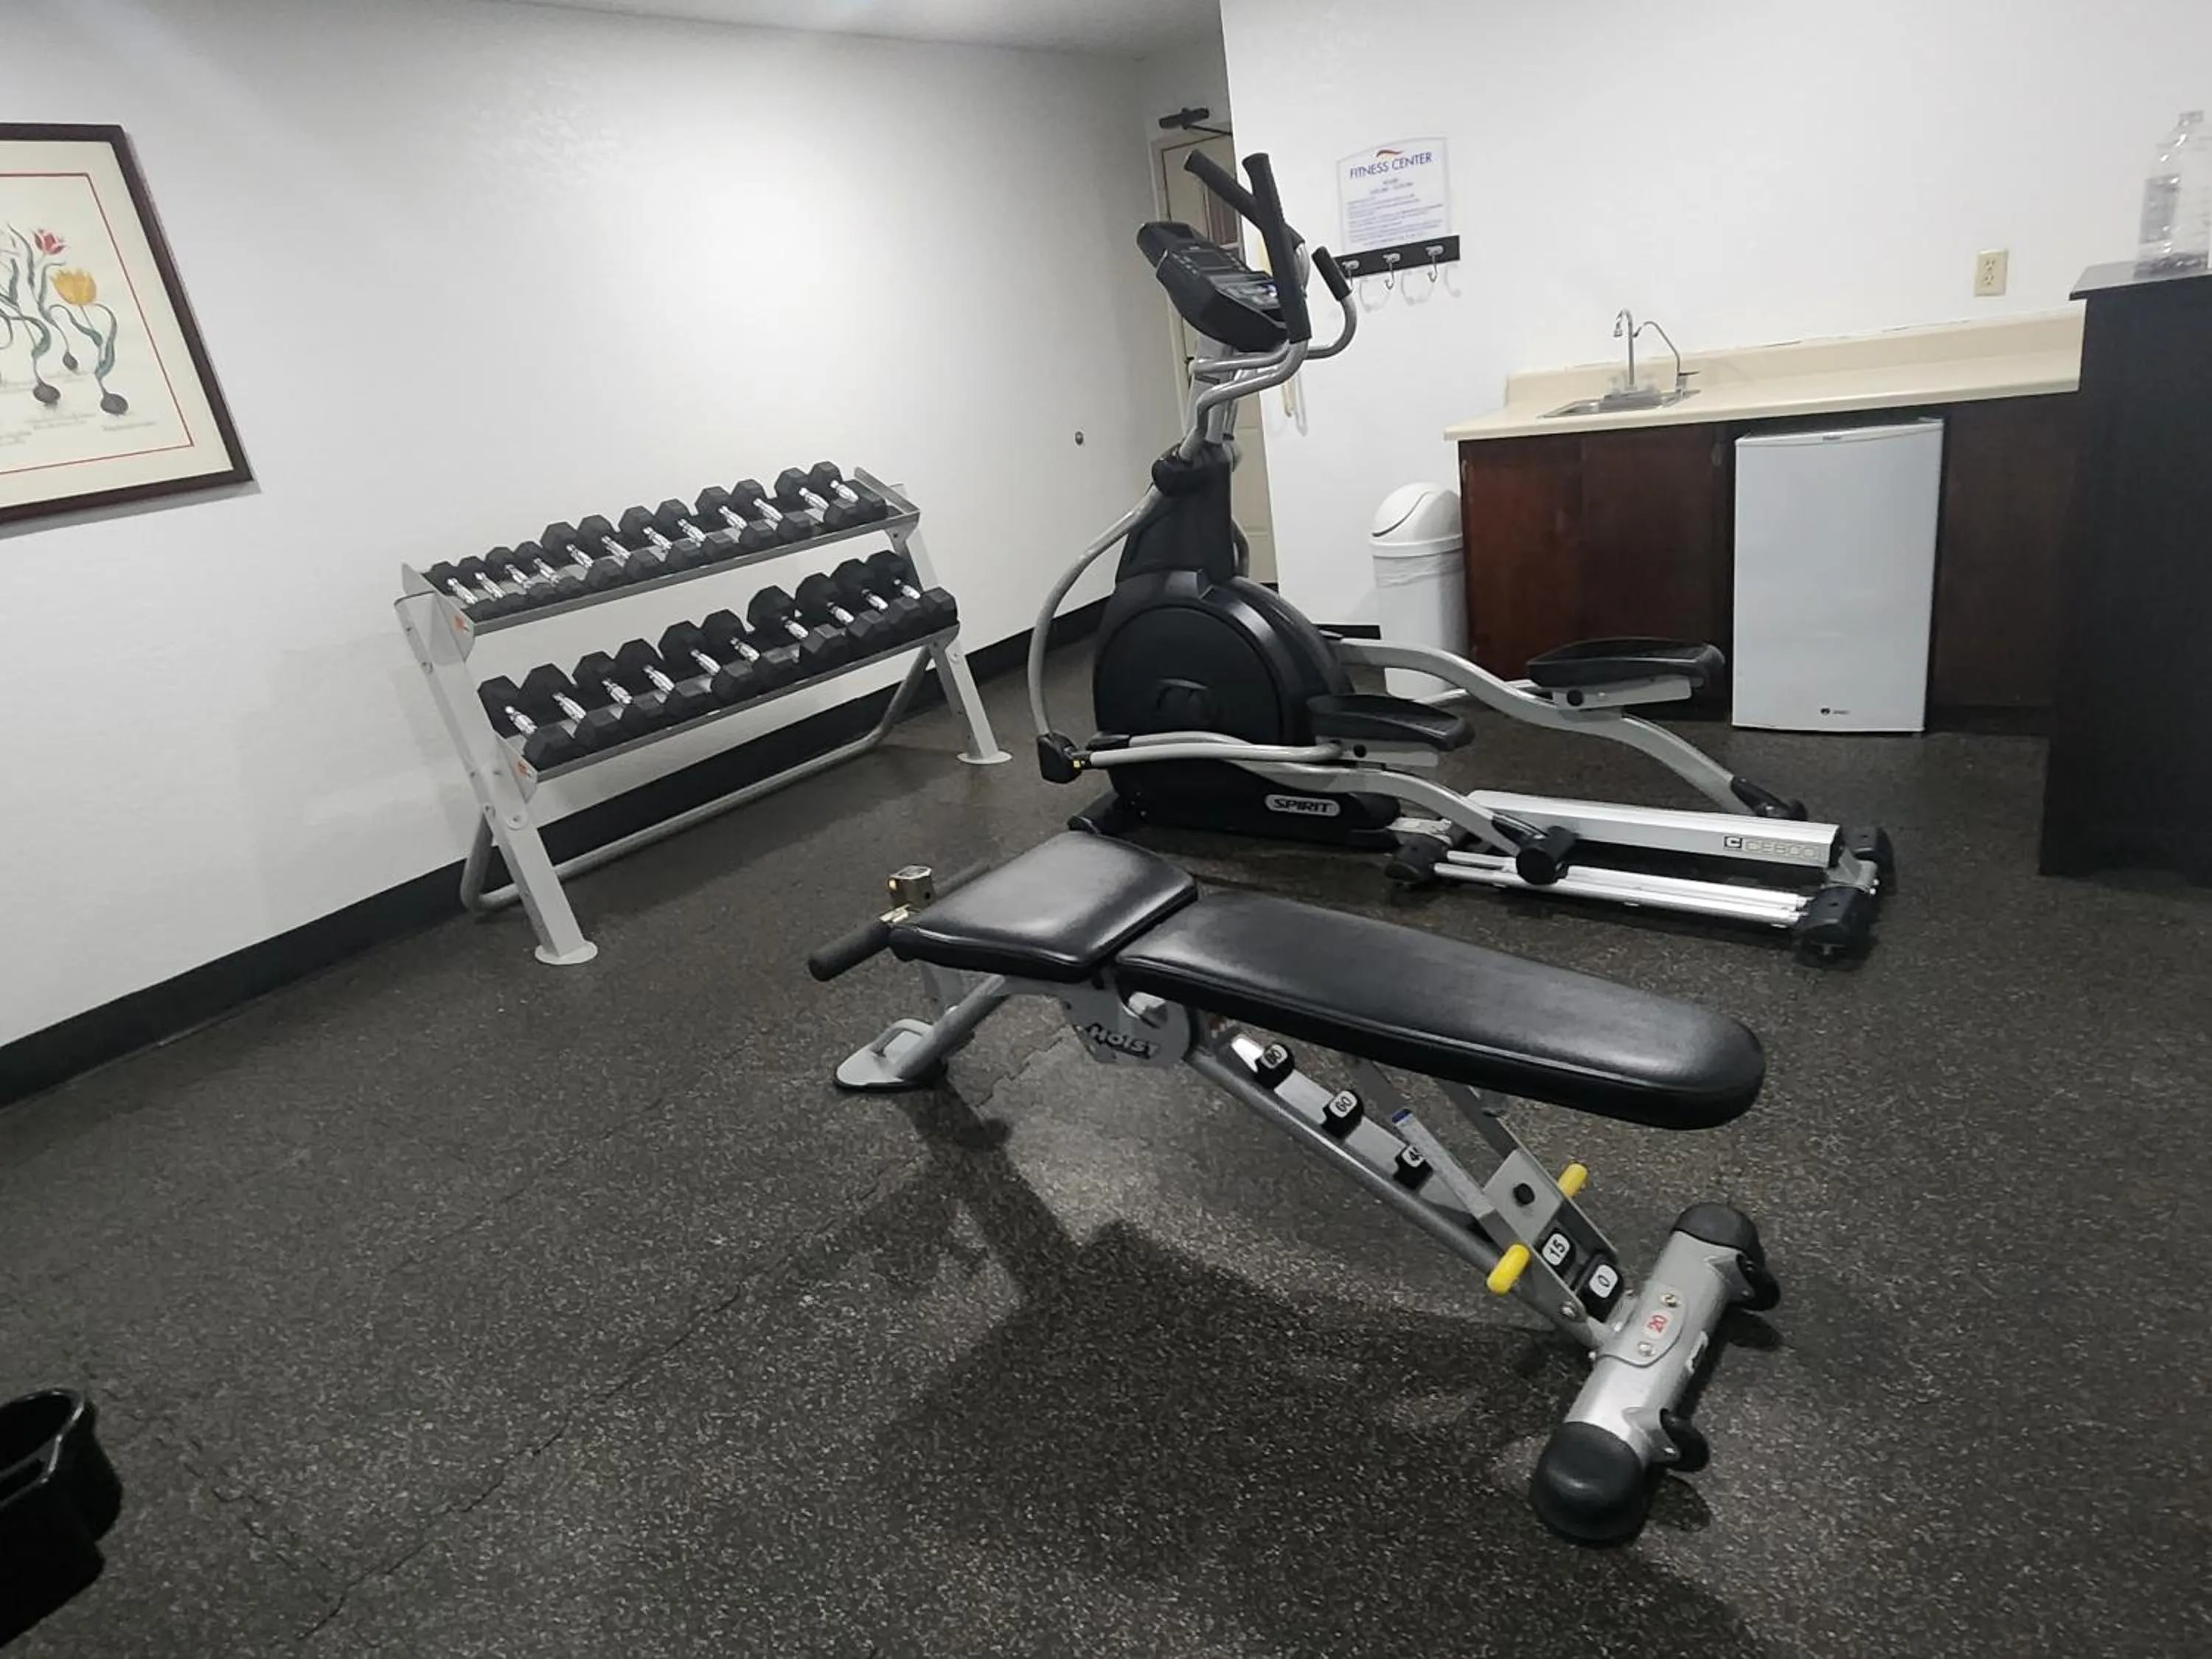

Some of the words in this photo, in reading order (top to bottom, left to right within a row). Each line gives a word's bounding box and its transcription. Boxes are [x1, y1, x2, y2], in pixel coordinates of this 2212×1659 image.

[1349, 163, 1389, 179] FITNESS
[1391, 152, 1433, 170] CENTER
[1273, 797, 1333, 813] SPIRIT
[1087, 1023, 1160, 1058] HOIST
[1335, 1096, 1352, 1112] 60
[1549, 1239, 1565, 1258] 15
[1597, 1275, 1610, 1287] 0
[1646, 1315, 1669, 1333] 20
